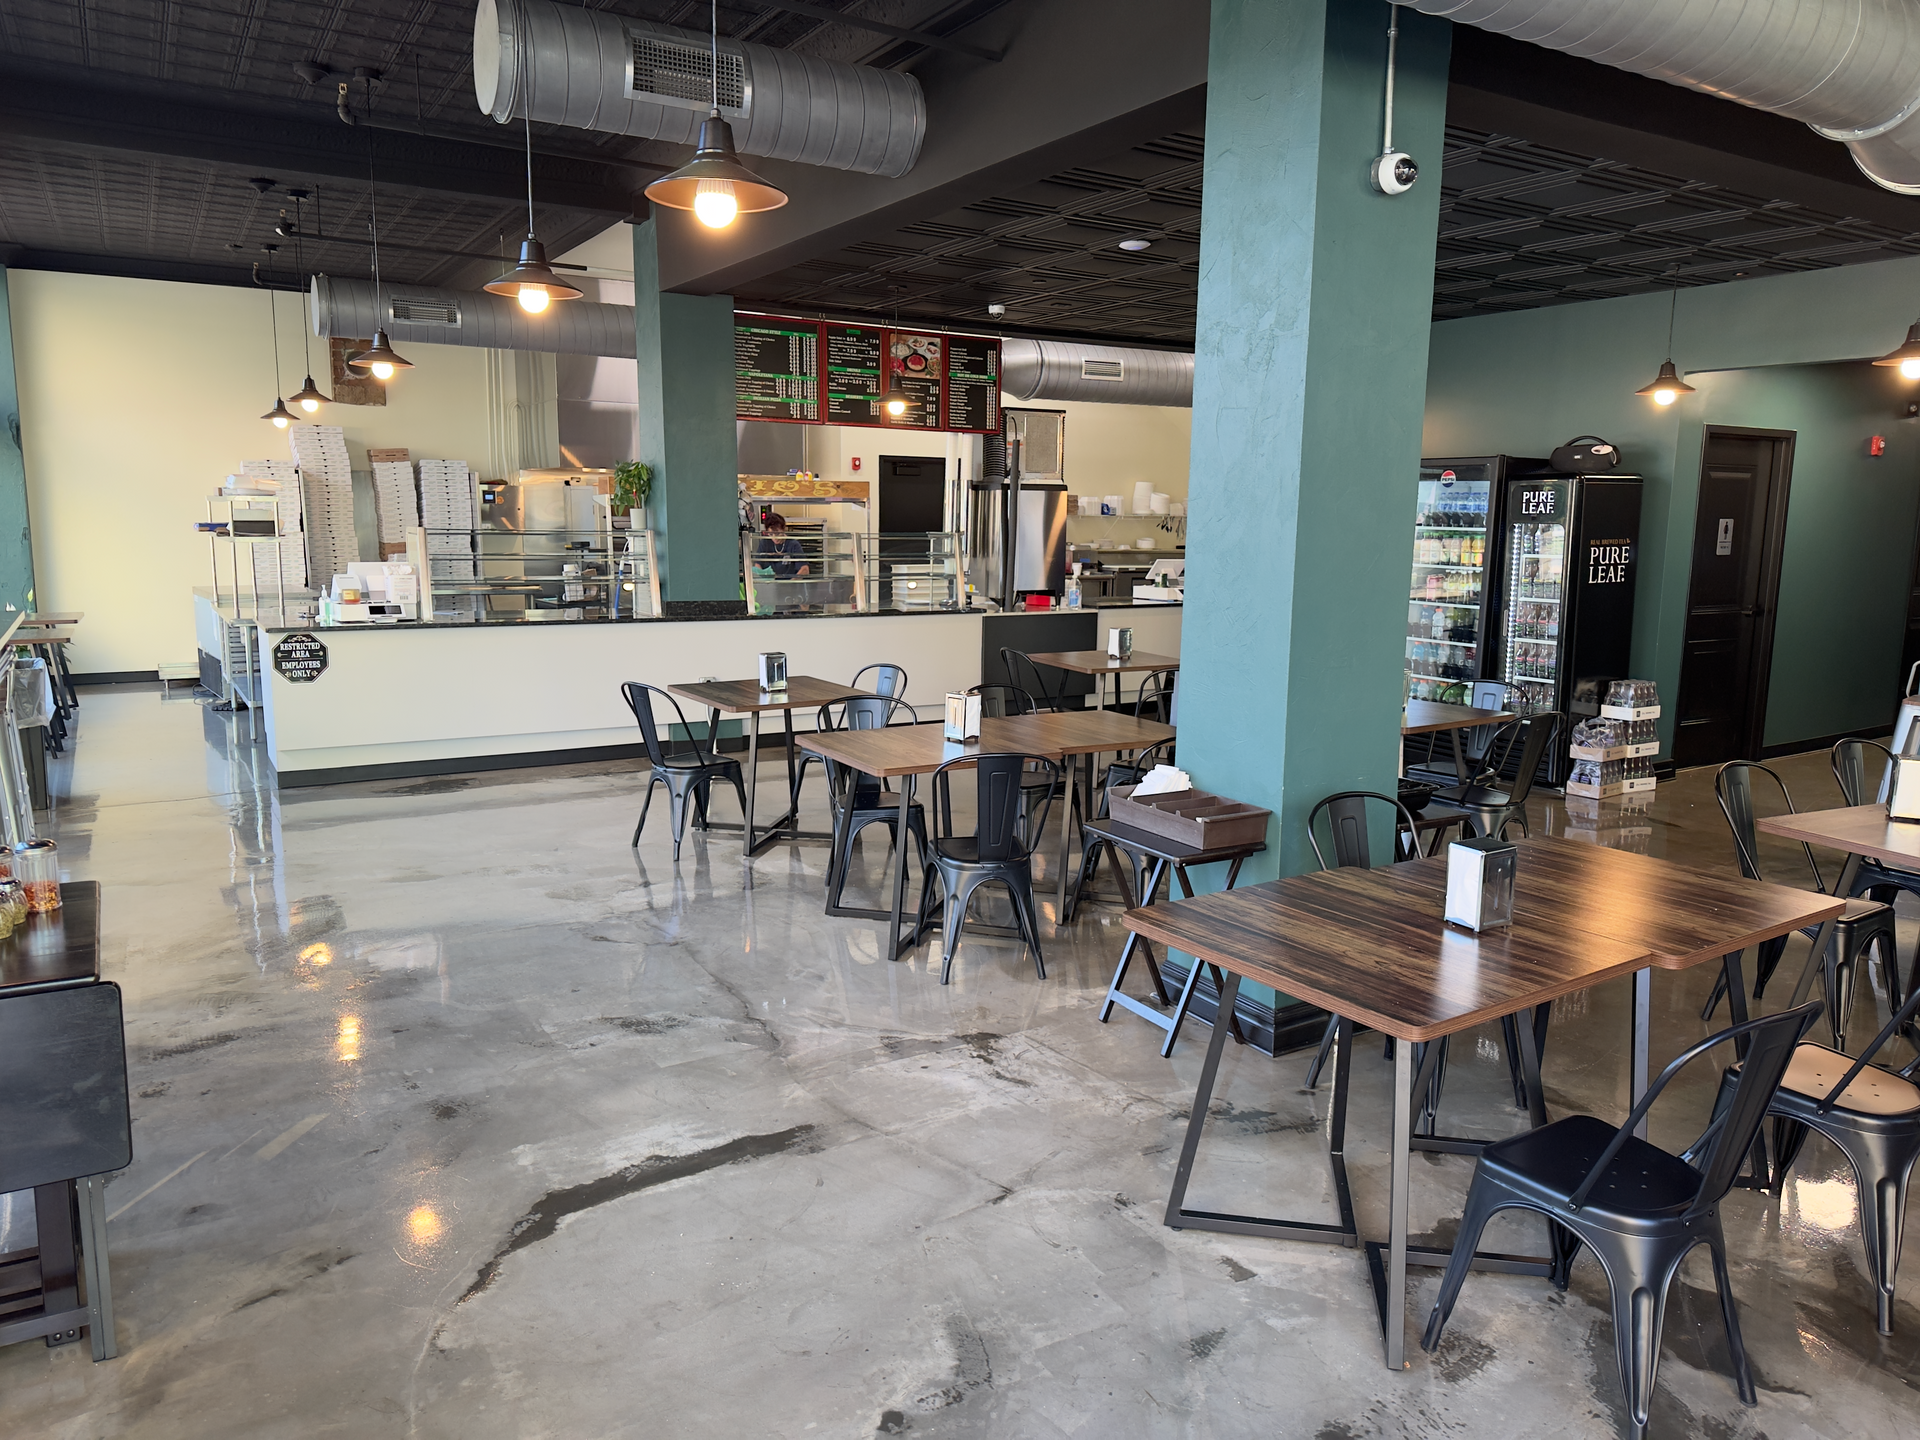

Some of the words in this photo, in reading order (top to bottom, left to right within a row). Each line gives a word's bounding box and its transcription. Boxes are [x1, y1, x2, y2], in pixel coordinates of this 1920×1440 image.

[1522, 491, 1555, 502] PURE
[1590, 546, 1630, 565] PURE
[281, 661, 320, 669] EMPLOYEES
